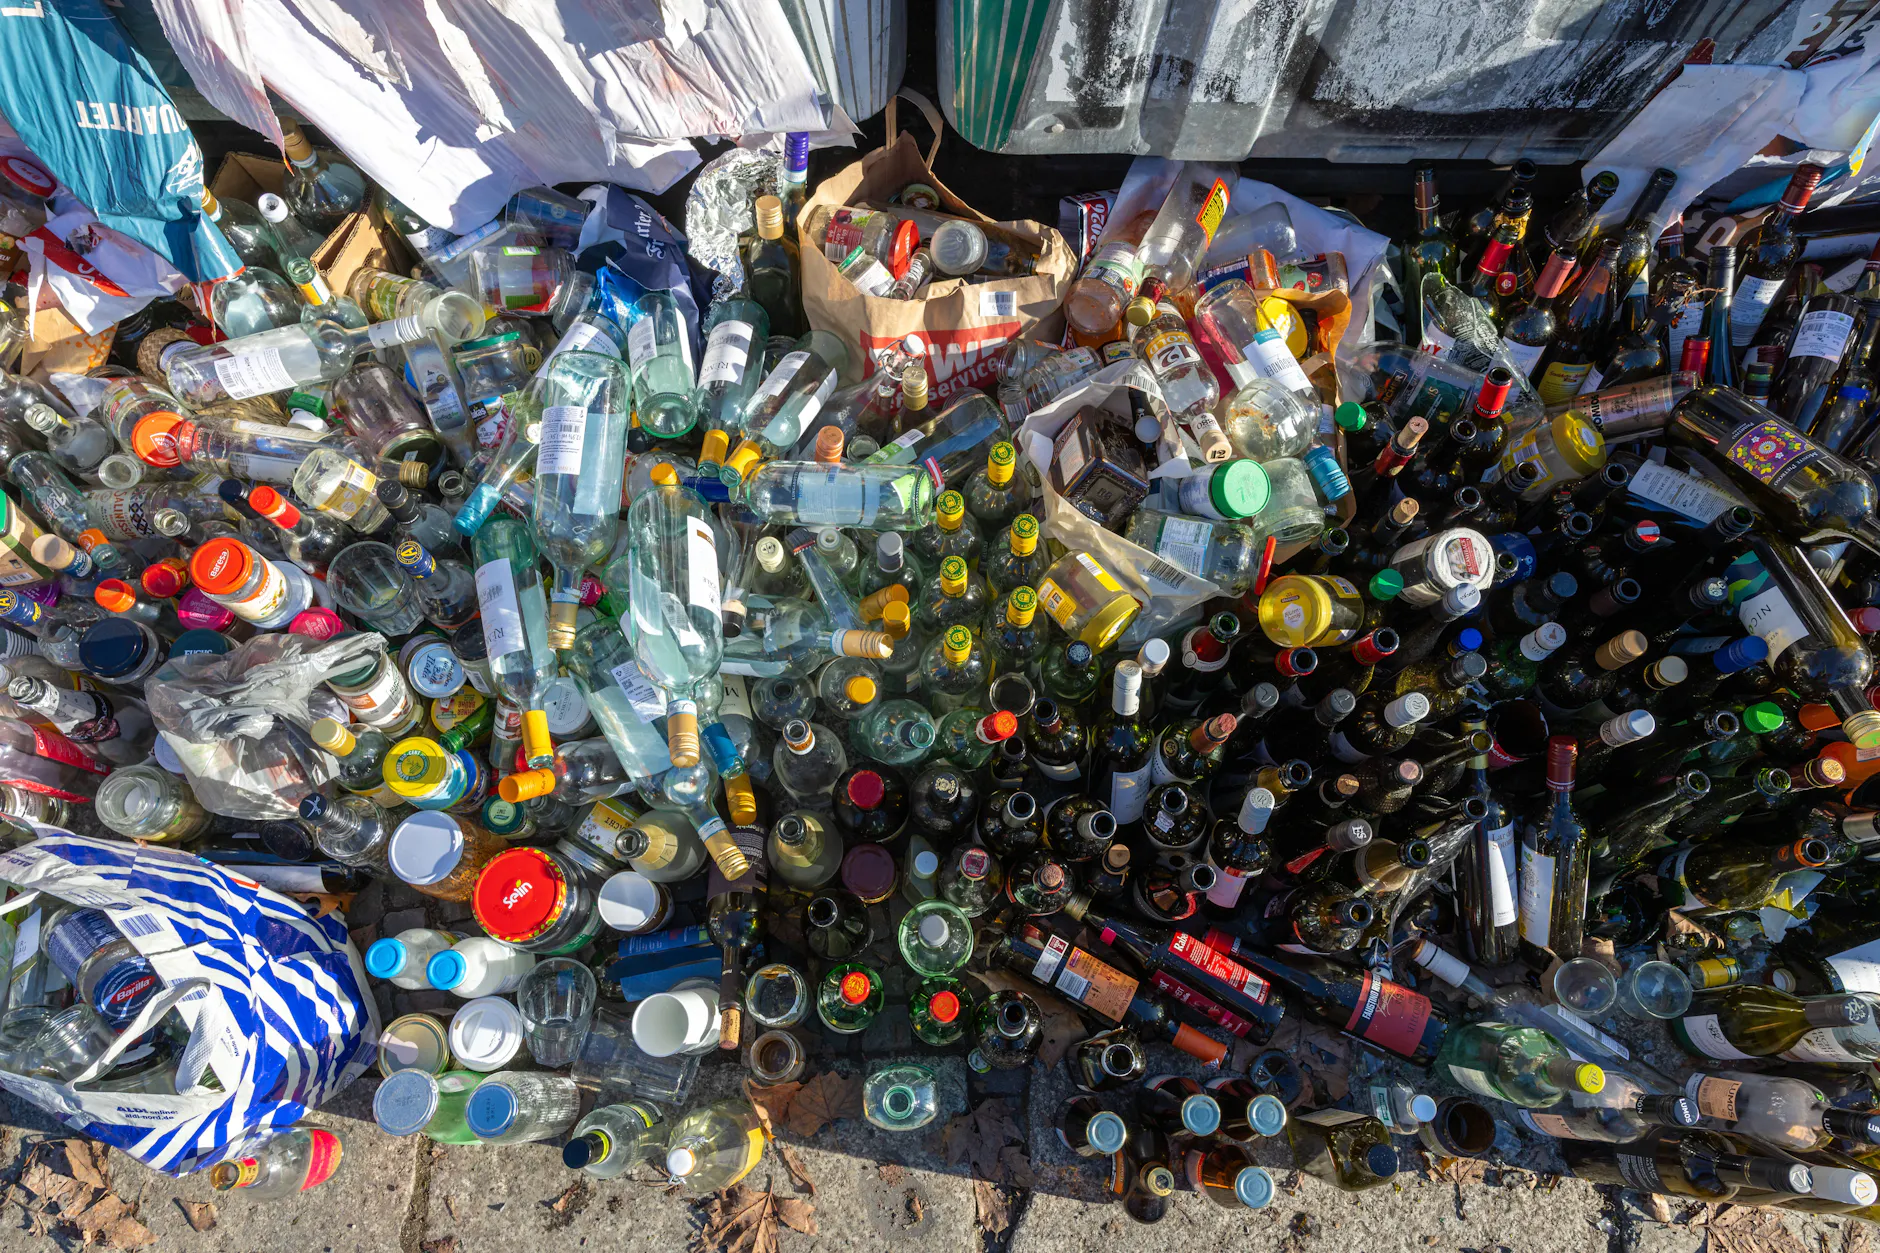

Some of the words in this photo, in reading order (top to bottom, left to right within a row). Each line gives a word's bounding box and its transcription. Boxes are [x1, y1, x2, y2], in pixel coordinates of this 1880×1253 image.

[1150, 335, 1190, 355] GOLD
[1157, 345, 1192, 368] 12
[1210, 450, 1226, 459] 12
[208, 549, 230, 578] Baresa
[502, 880, 534, 910] Selin
[117, 978, 151, 1002] Barilla
[1362, 990, 1379, 1020] FAUSTINO
[117, 1105, 149, 1113] ALDI
[1679, 1098, 1694, 1124] LUMOS
[1727, 1082, 1742, 1119] LUMOS
[125, 1112, 175, 1121] aldi-nord.de
